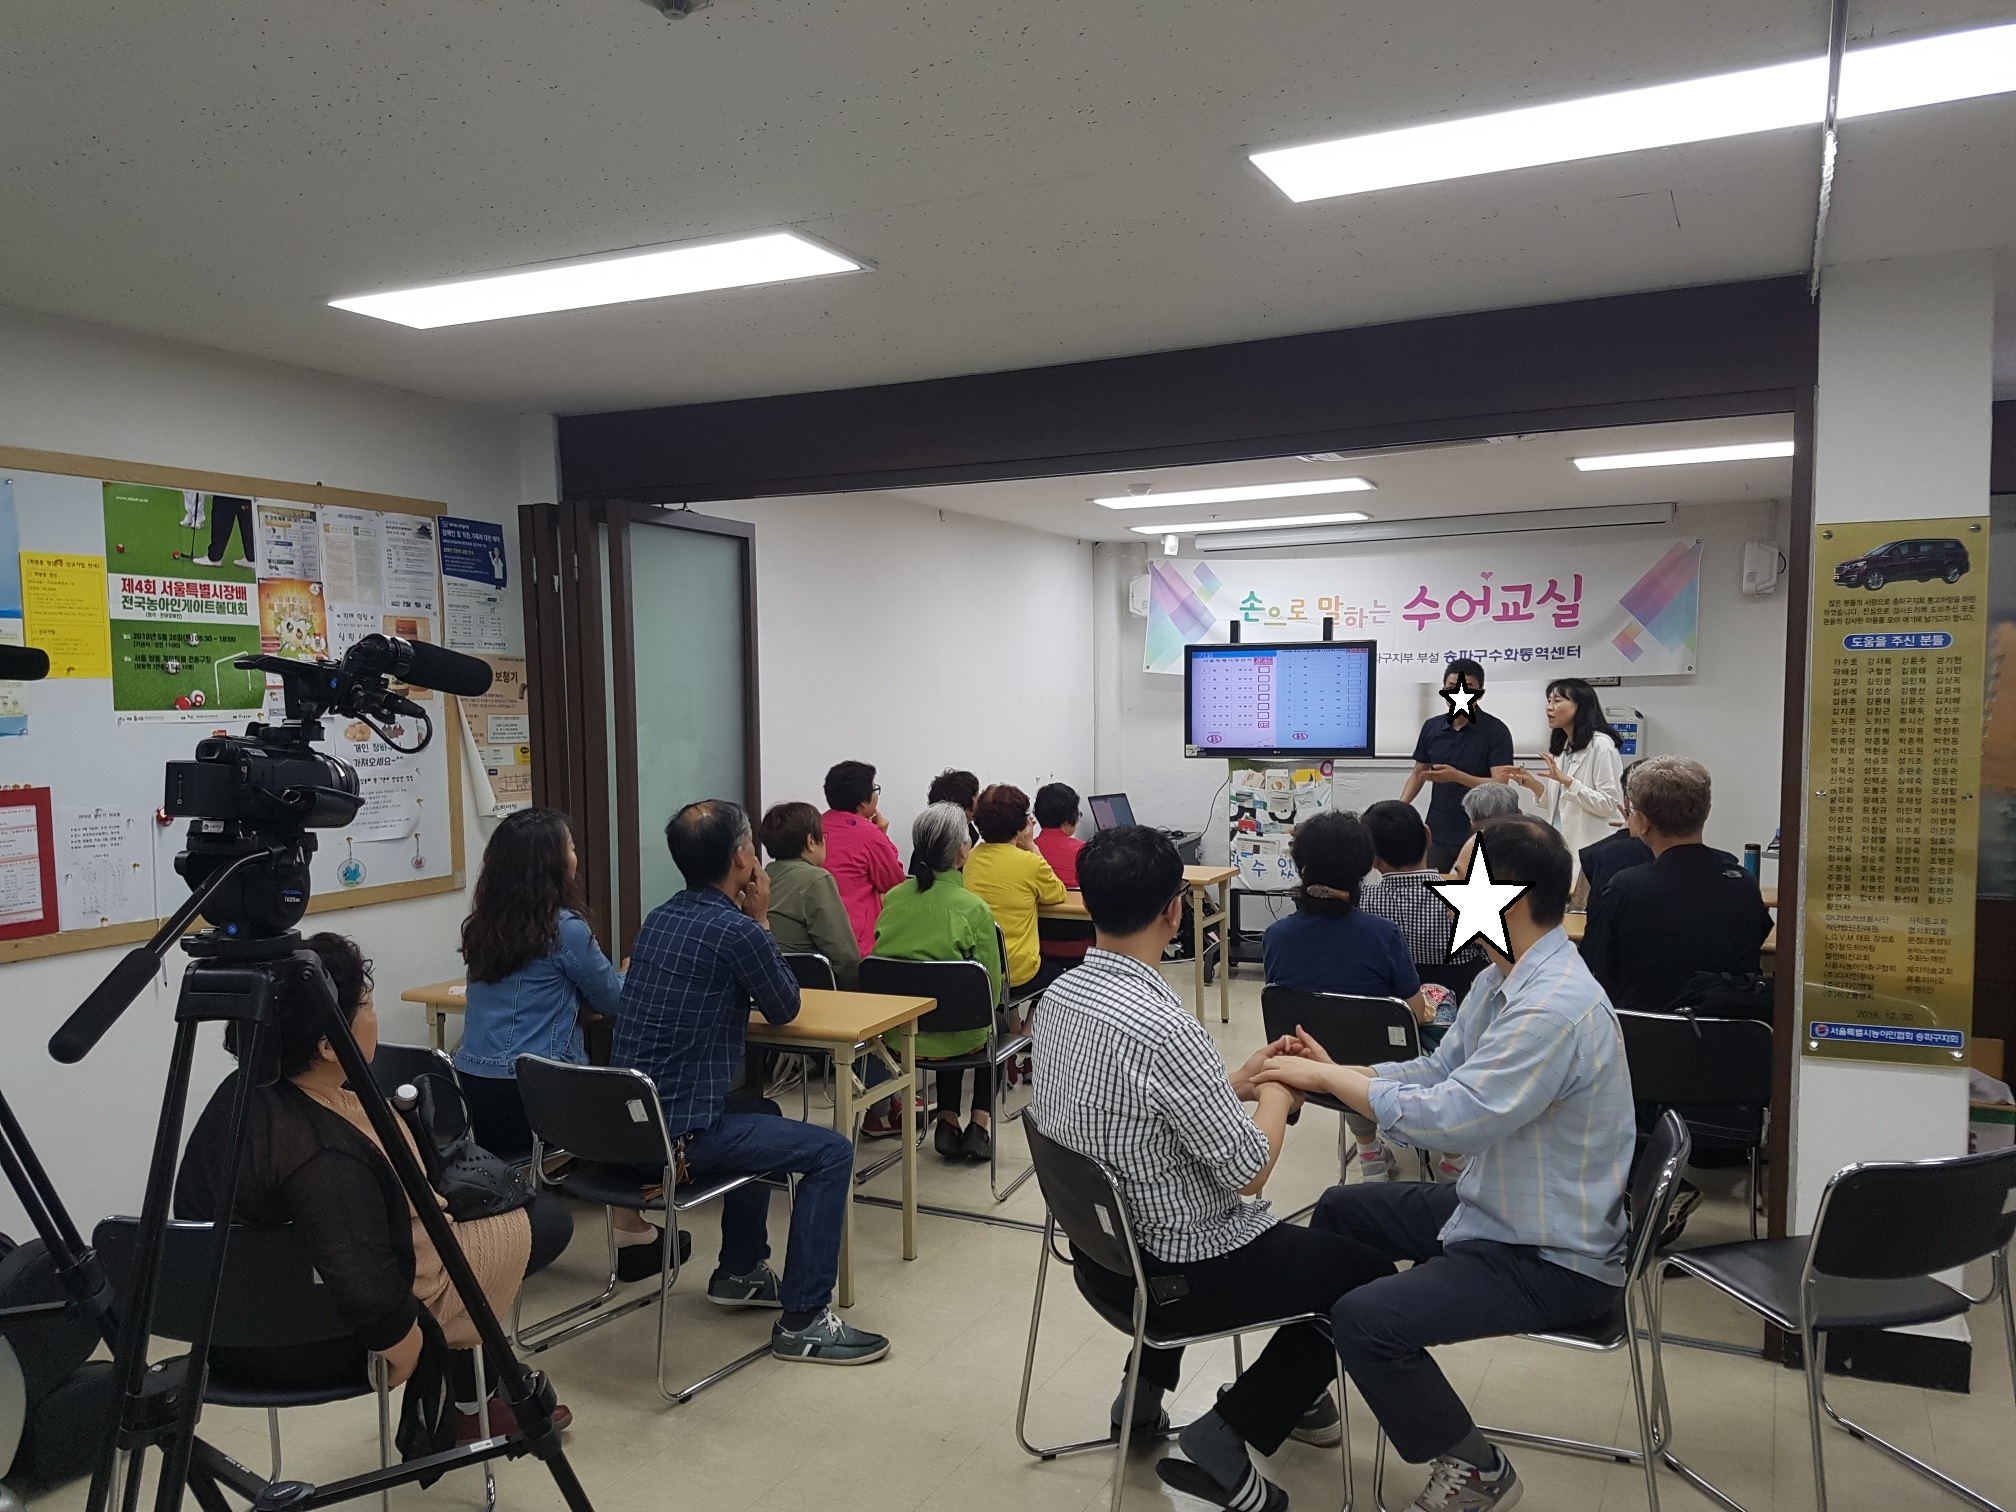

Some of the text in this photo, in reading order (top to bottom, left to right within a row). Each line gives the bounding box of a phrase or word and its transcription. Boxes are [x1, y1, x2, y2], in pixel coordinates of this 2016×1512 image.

[121, 578, 247, 601] 제4회 서울특별시장배
[121, 595, 248, 616] 전국농아인게이트볼대회
[1239, 573, 1584, 631] 손으로 말하는 수어교실
[1850, 635, 1945, 647] 도움을 주신 분들
[1416, 652, 1439, 664] 부설
[1443, 645, 1582, 664] 송파구수화통역센터
[494, 671, 518, 684] 보청기
[354, 743, 369, 753] 개인
[1251, 859, 1267, 878] 수
[1830, 1026, 1959, 1044] 서울특별시농아인협회 송파구지회
